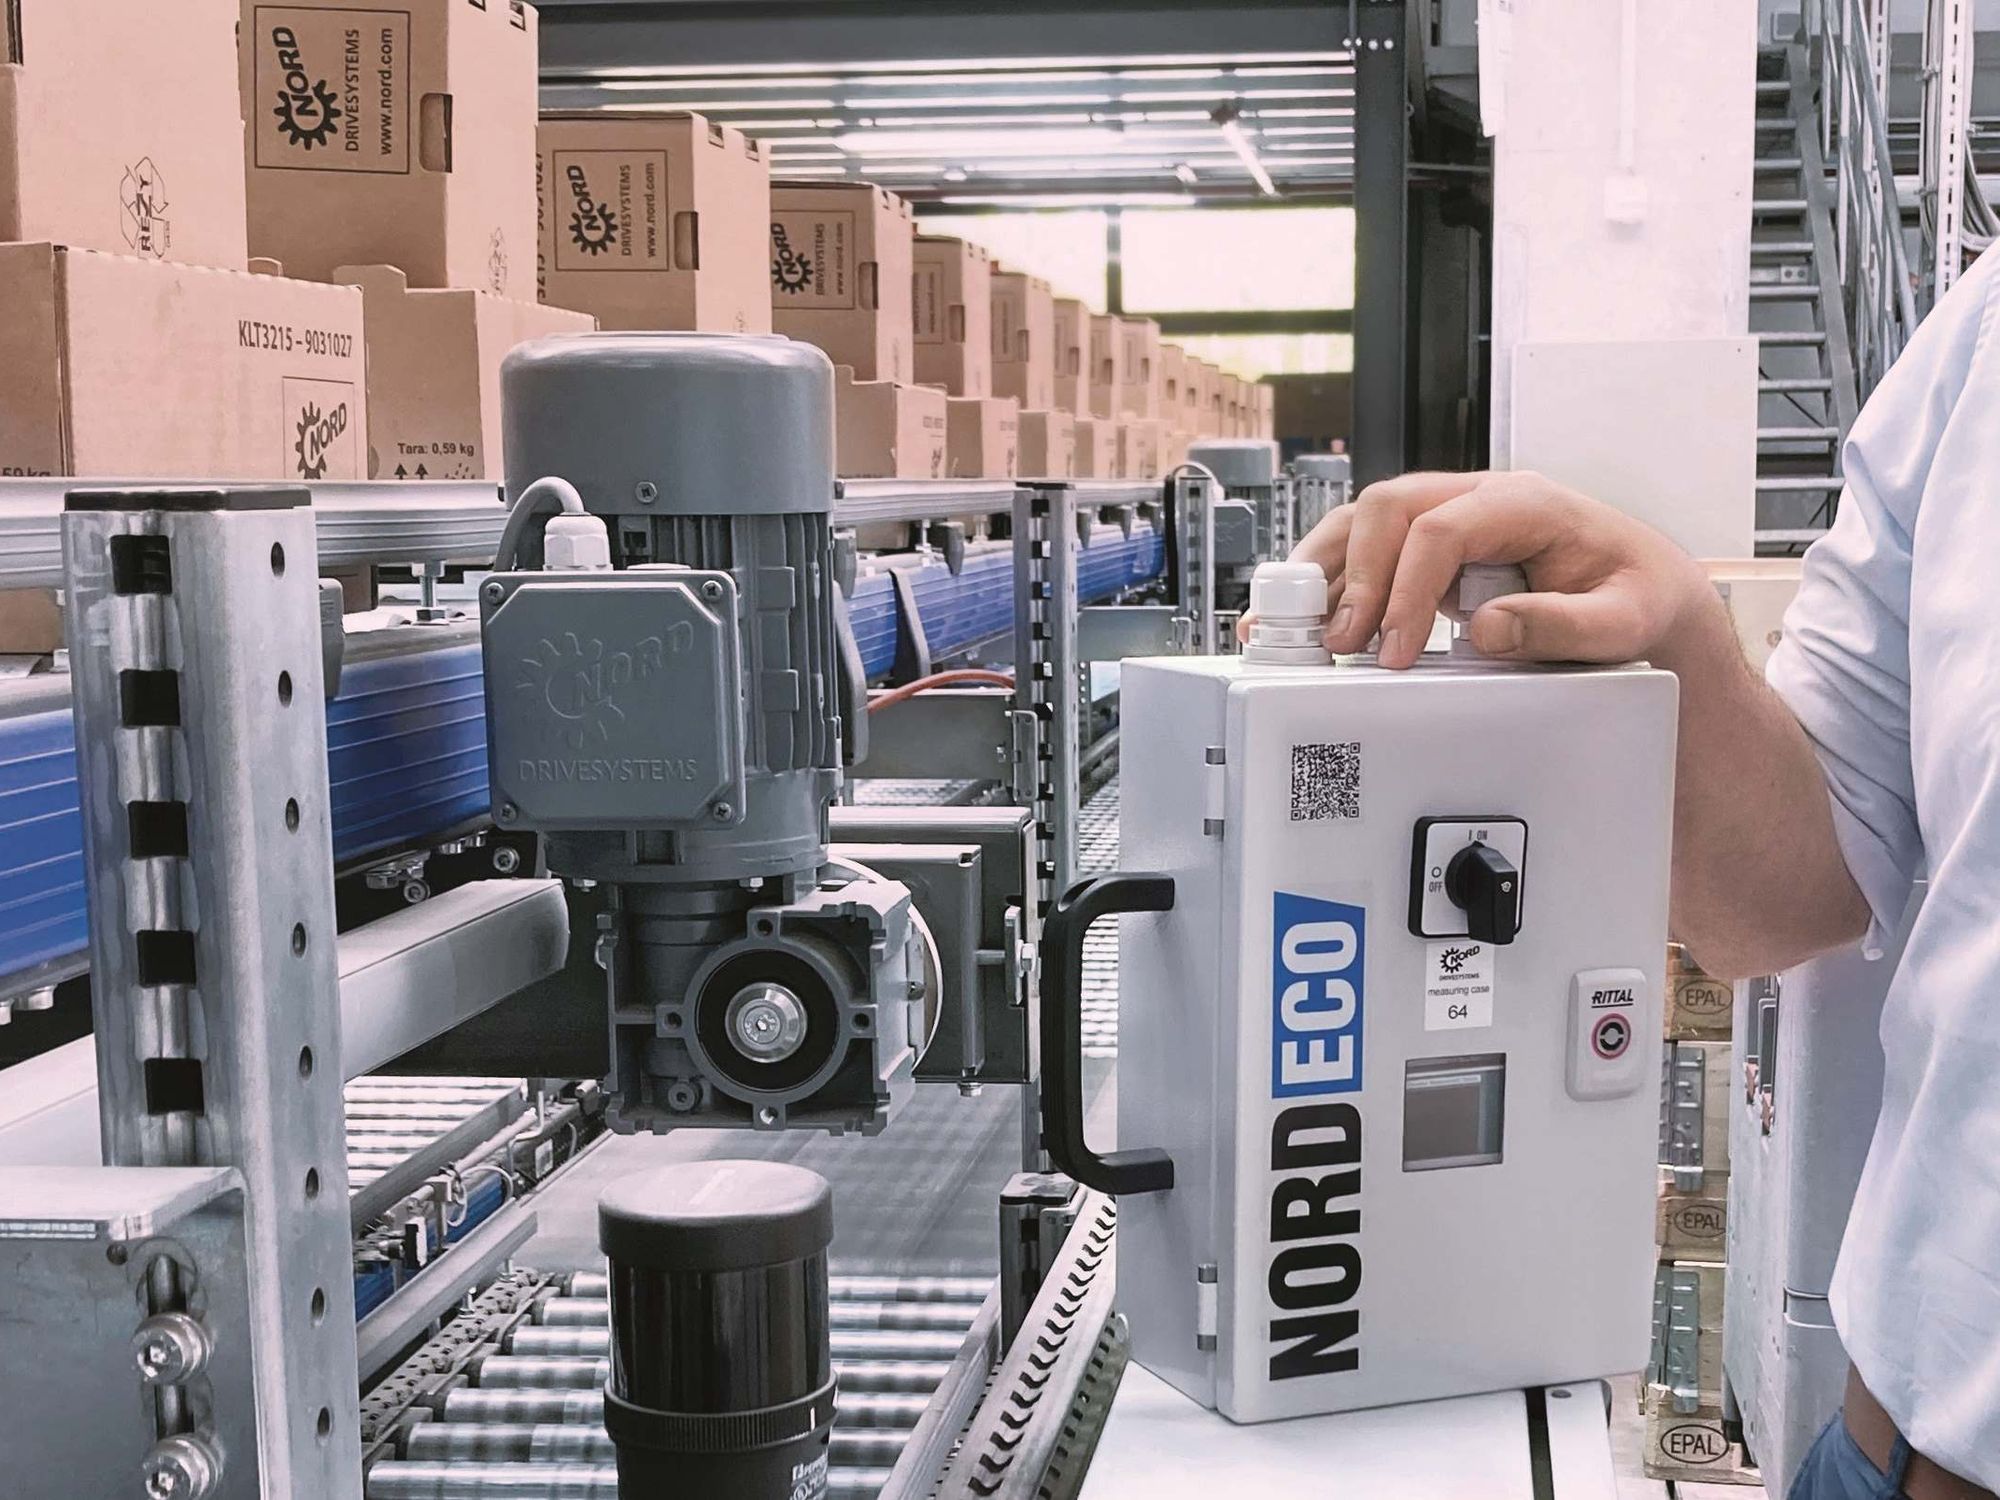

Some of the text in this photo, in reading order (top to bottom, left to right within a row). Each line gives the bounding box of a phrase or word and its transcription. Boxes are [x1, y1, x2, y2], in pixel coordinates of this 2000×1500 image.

[272, 27, 318, 116] NORD
[345, 29, 359, 151] DRIVESYSTEMS
[378, 28, 392, 155] www.nord.com
[566, 165, 601, 230] NORD
[619, 164, 632, 256] DRIVESYSTEMS
[644, 163, 656, 257] www.nord.com
[770, 222, 799, 274] NORD
[310, 402, 347, 461] NORD
[397, 442, 475, 457] Tara: 0,59 kg
[576, 620, 694, 706] NORD
[519, 759, 698, 782] DRIVESYSTEMS
[1476, 829, 1488, 841] ON
[1428, 881, 1443, 893] OFF
[1450, 945, 1481, 965] NORD
[1439, 972, 1480, 981] DRIVESYSTEMS
[1428, 985, 1490, 996] measuring case
[1591, 988, 1634, 1004] RITTAL
[1685, 988, 1726, 1006] EPAL
[1448, 1004, 1468, 1020] 64
[1683, 1212, 1726, 1232] EPAL
[1670, 1433, 1720, 1456] EPAL
